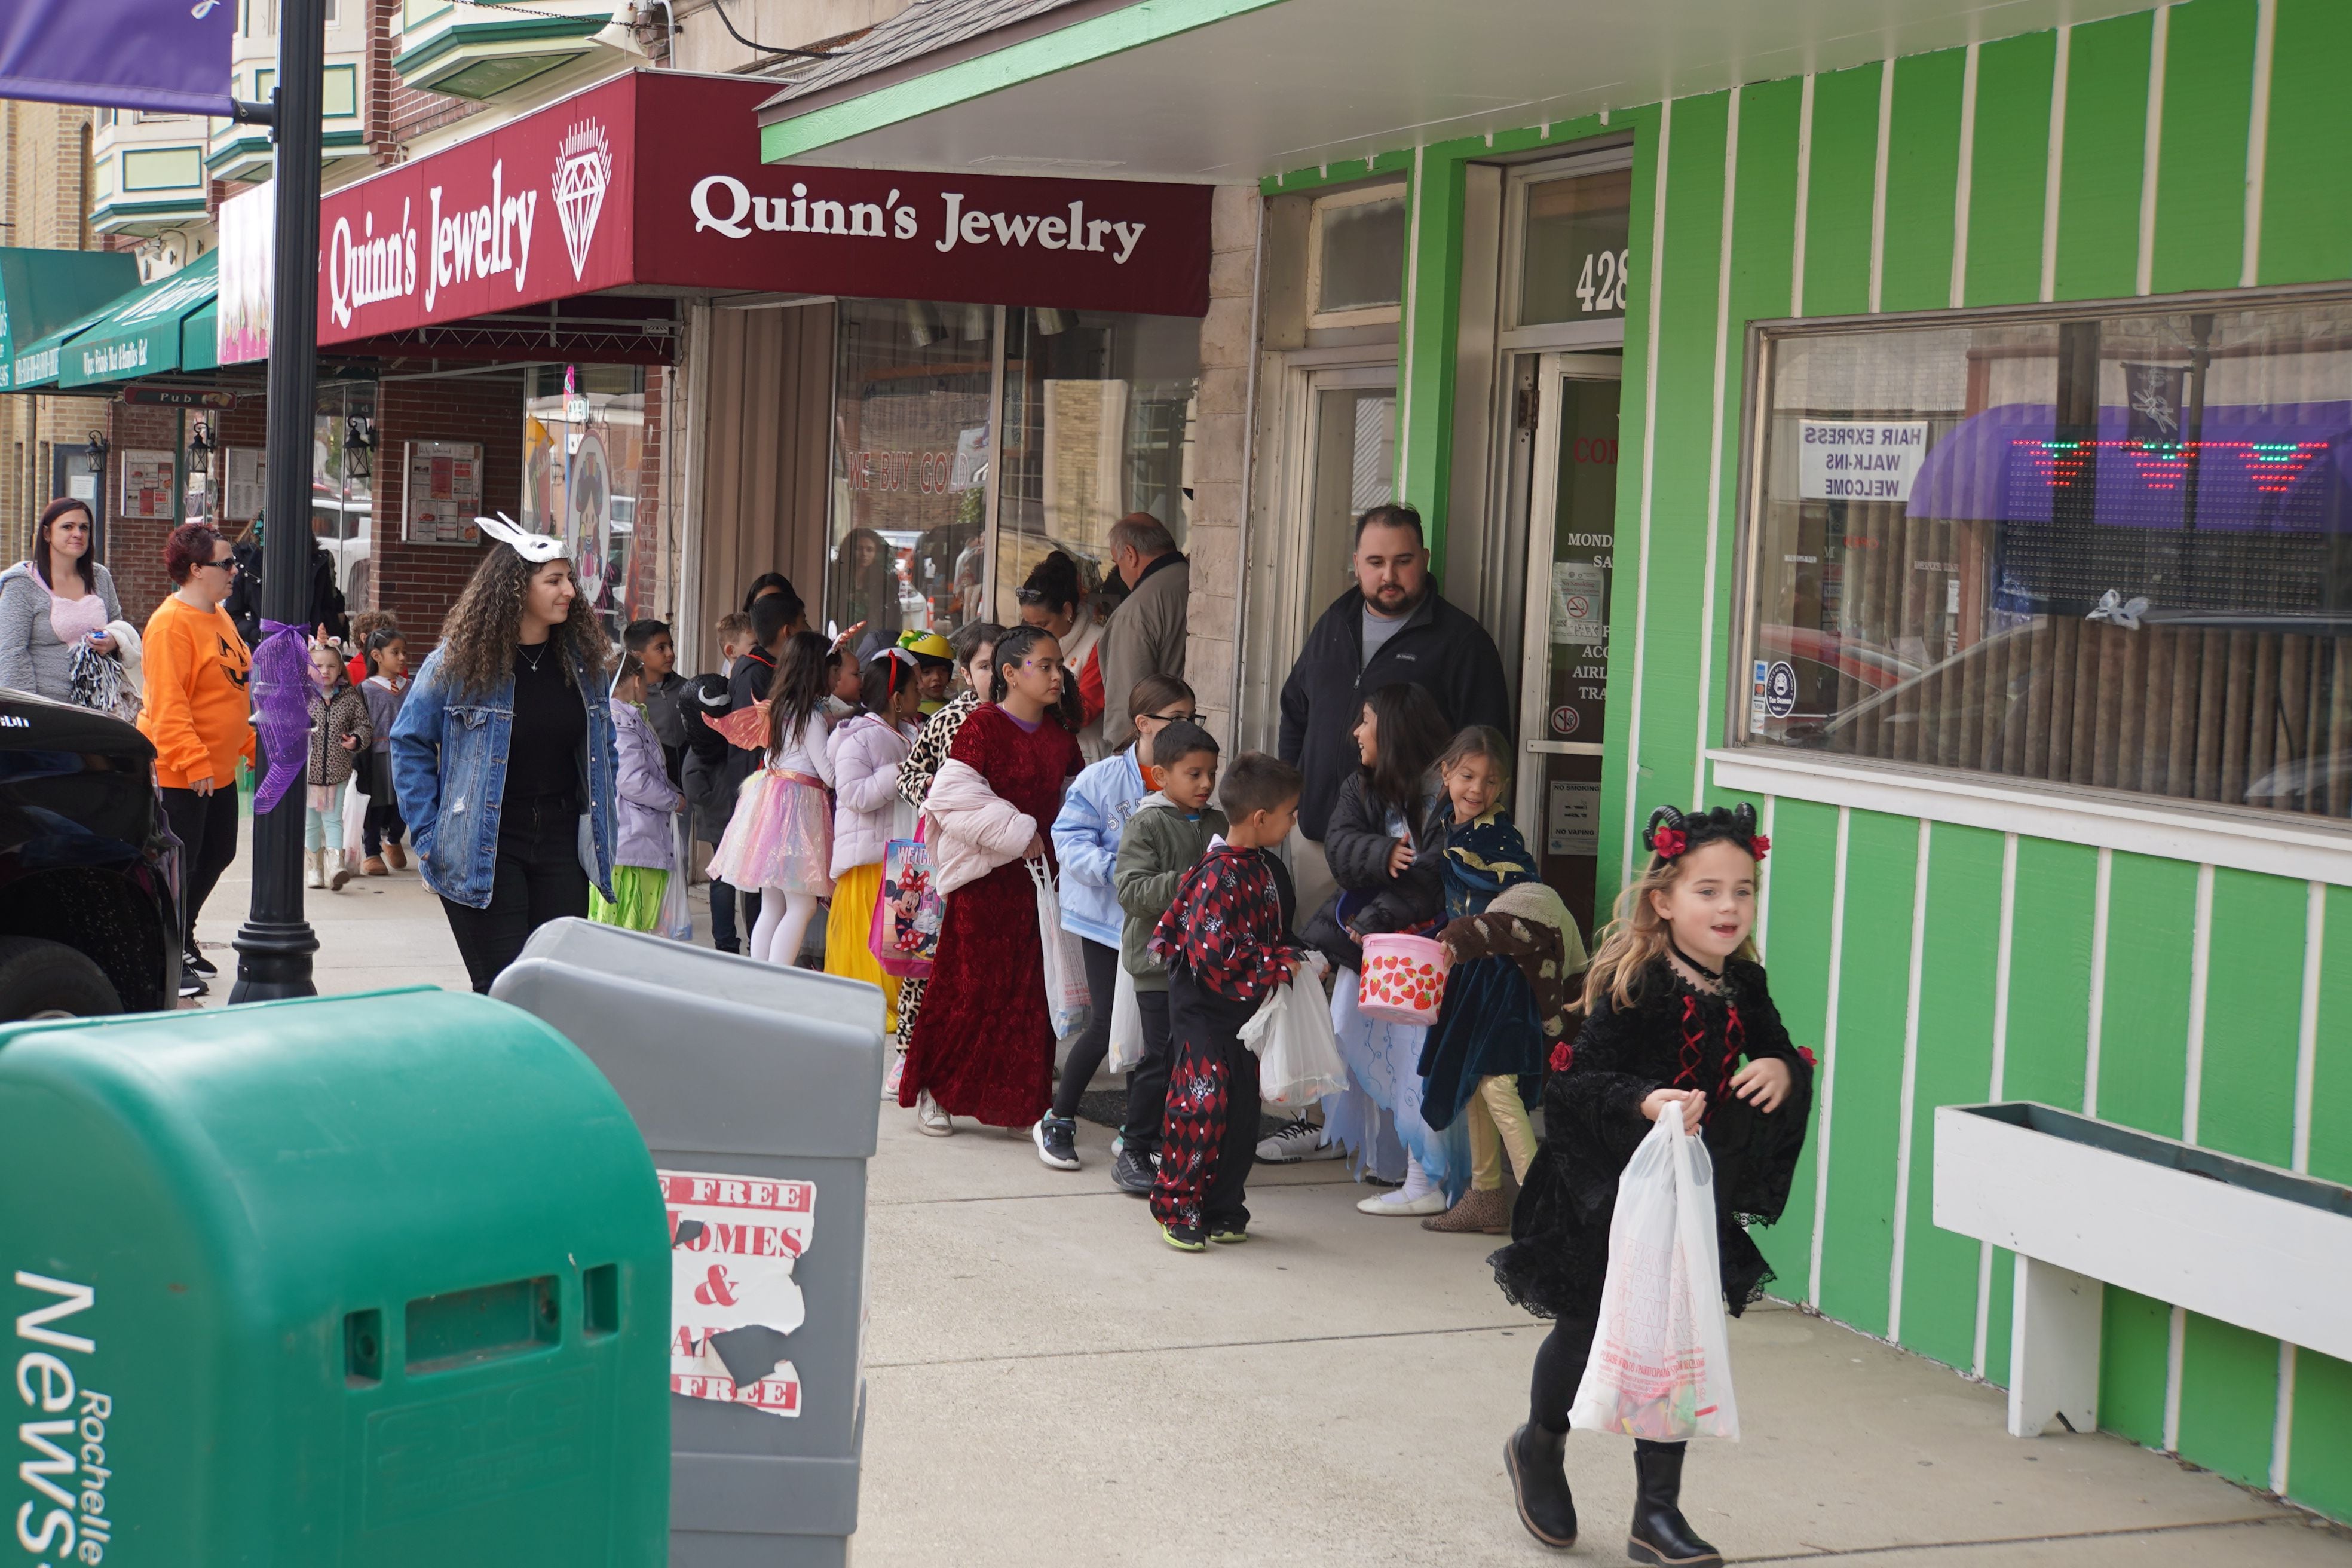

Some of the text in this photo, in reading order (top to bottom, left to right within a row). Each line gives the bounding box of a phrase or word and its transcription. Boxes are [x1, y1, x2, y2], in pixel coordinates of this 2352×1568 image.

[690, 175, 1146, 265] Quinn's Jewelry
[330, 158, 537, 329] Quinn's Jewelry
[160, 393, 192, 403] Pub
[849, 451, 970, 495] WE BUY GOLD
[1568, 533, 1614, 547] MOND
[1572, 624, 1598, 638] TAX
[691, 1178, 801, 1208] FREE
[694, 1264, 739, 1307] &
[15, 1269, 96, 1560] News
[79, 1389, 112, 1567] Rochelle
